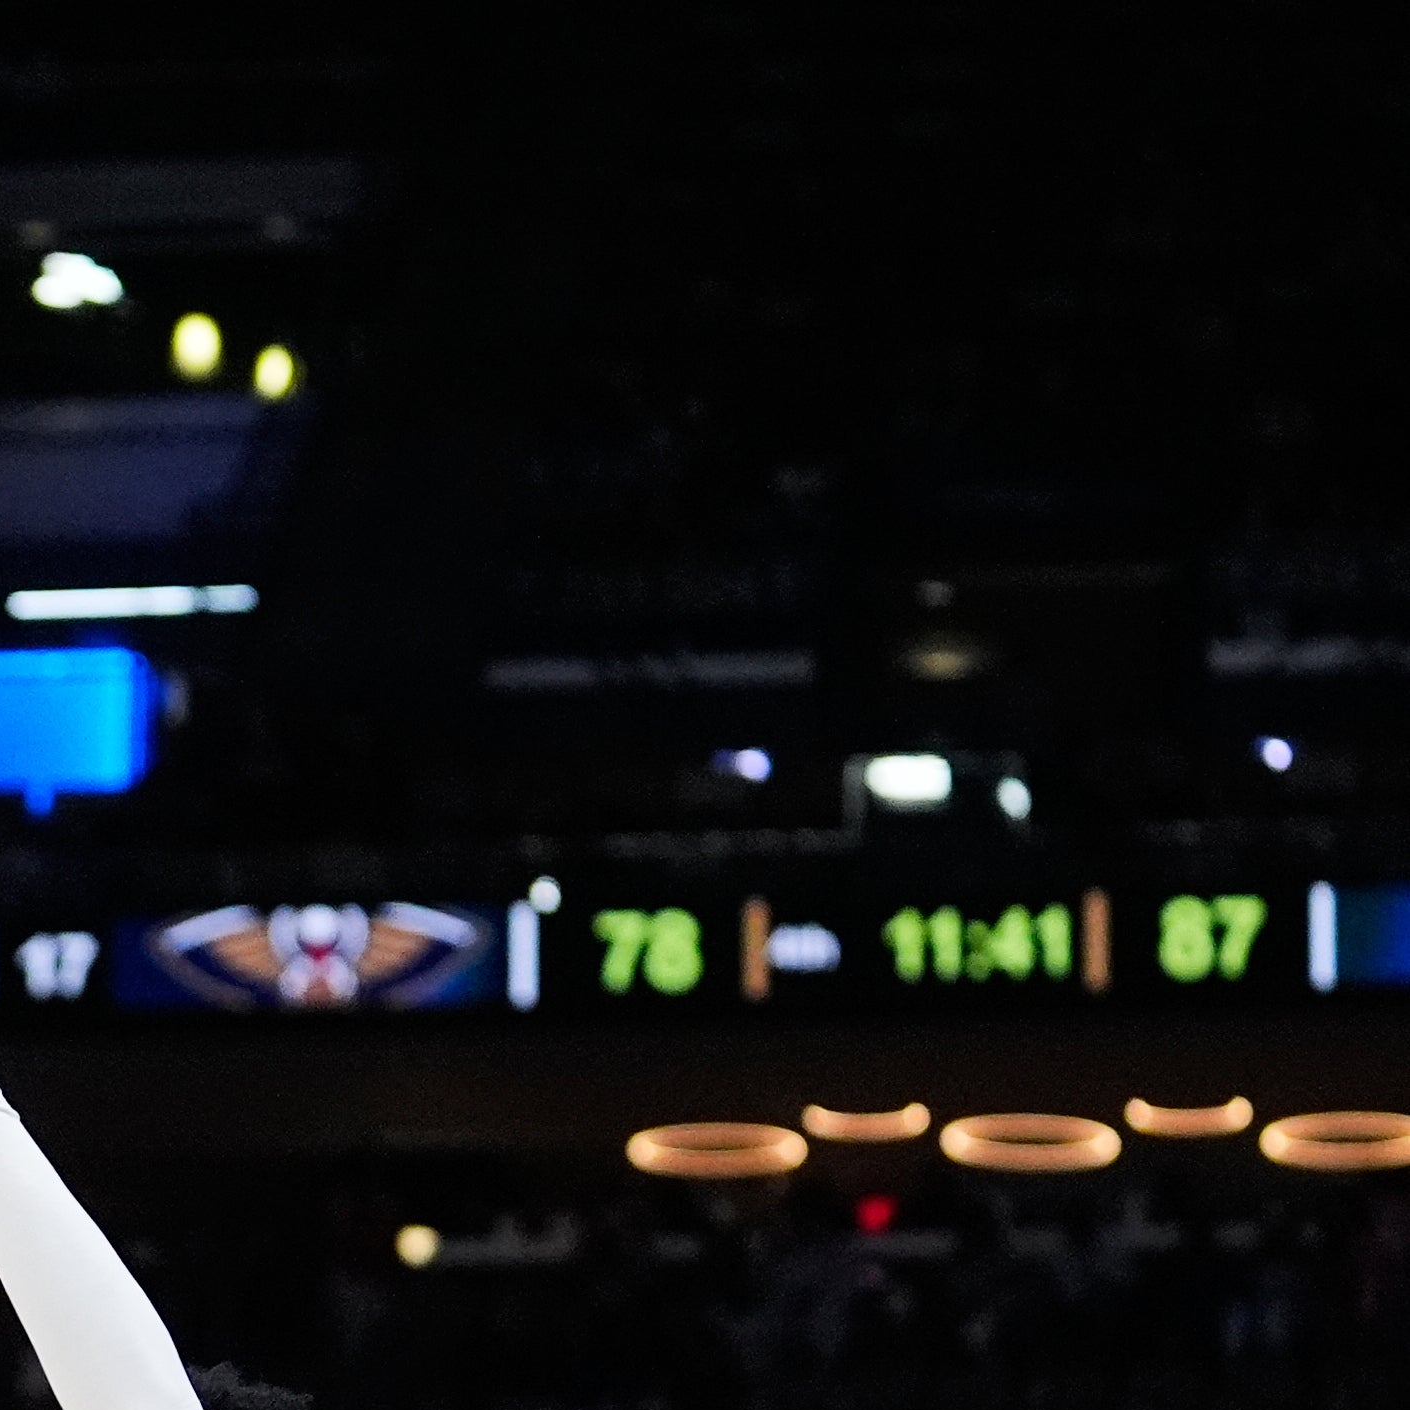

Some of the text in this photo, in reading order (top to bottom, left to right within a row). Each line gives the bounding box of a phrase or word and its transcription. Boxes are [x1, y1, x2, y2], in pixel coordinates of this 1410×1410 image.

[592, 907, 703, 994] 78
[882, 904, 1073, 983] 11:41
[1158, 894, 1267, 983] 87
